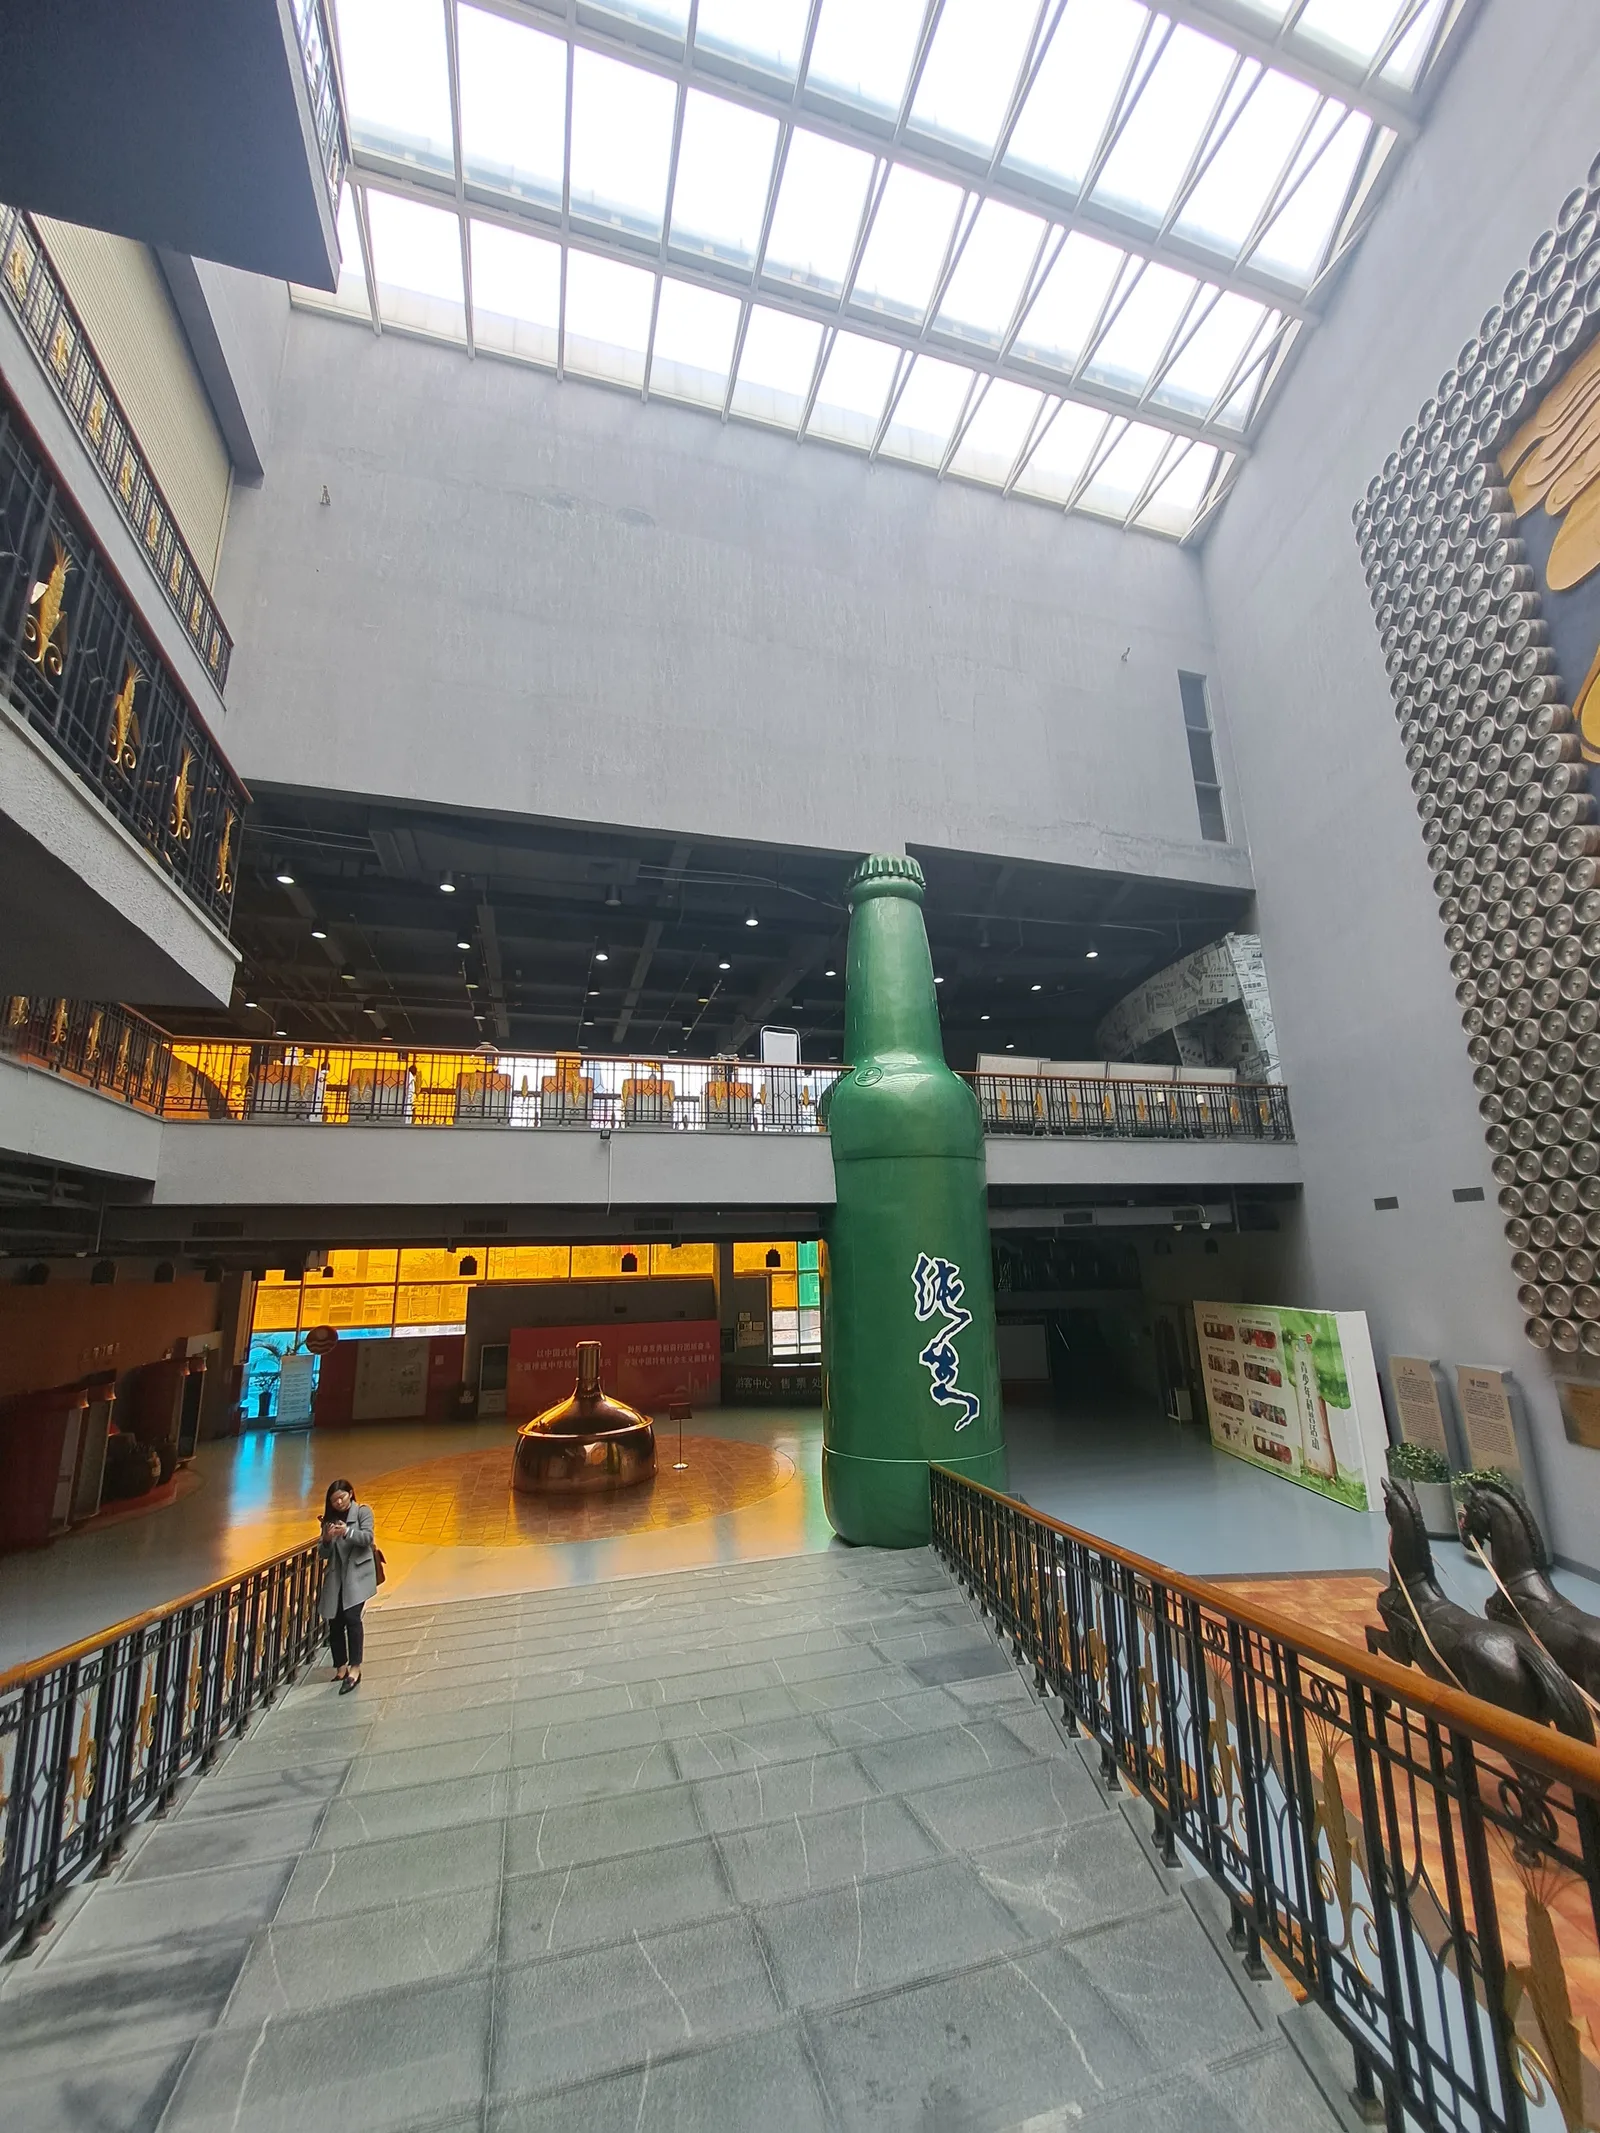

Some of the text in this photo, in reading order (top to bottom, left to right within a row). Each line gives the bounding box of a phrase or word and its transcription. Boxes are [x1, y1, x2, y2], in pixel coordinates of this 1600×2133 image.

[735, 1376, 822, 1390] 游客中心 售票处
